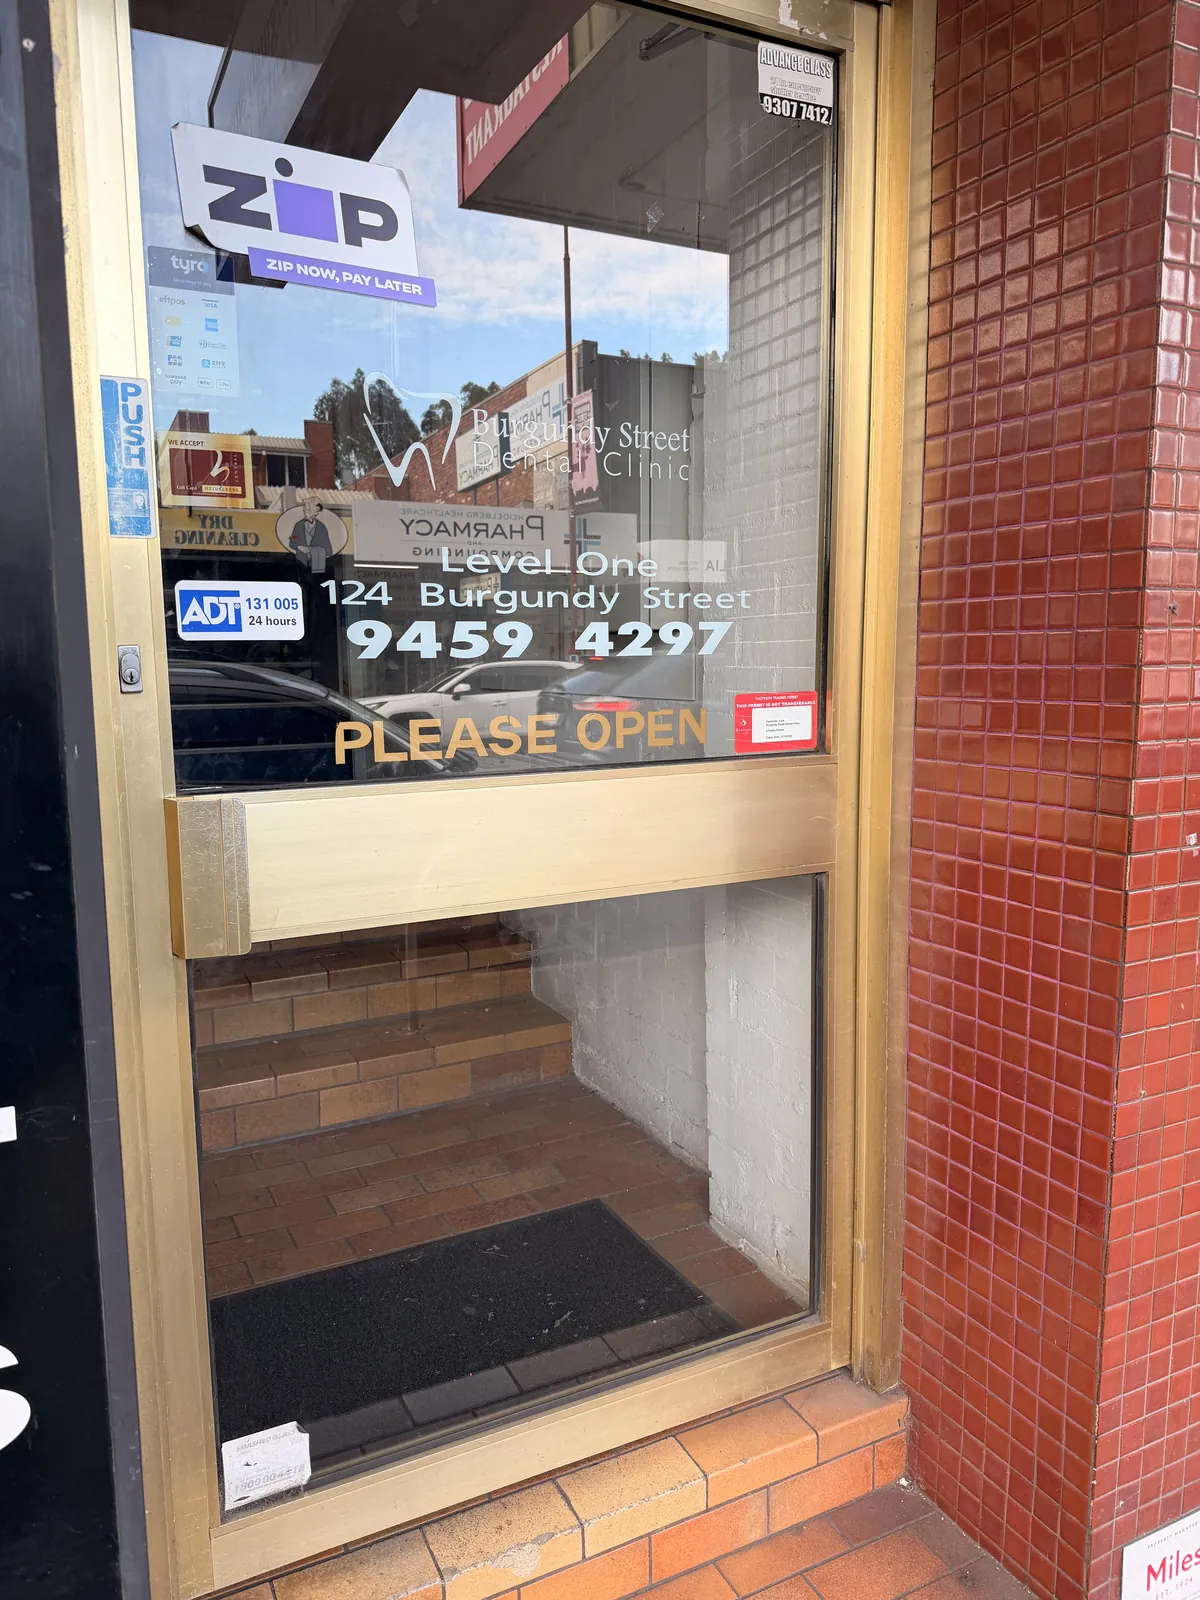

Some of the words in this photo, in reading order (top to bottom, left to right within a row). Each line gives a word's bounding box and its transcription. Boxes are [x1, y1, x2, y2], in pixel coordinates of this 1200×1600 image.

[760, 46, 803, 72] ADVANCE
[804, 56, 833, 79] GLASS
[763, 95, 797, 118] 9307
[800, 103, 829, 125] 7412
[794, 91, 816, 102] service
[171, 254, 209, 275] tyro
[266, 257, 294, 272] ZIP
[296, 263, 340, 284] NOW,
[342, 271, 371, 286] PAY
[375, 276, 423, 296] LATER
[159, 295, 186, 306] eftpos
[120, 382, 147, 468] PUSH
[471, 408, 611, 452] Burgundy
[619, 421, 690, 452] Street
[473, 441, 582, 474] Dental
[603, 452, 690, 481] Clinic
[441, 546, 551, 575] Level
[576, 551, 658, 577] One
[181, 596, 240, 625] ADT
[245, 598, 269, 610] 131
[274, 598, 299, 610] 005
[320, 579, 393, 606] 124
[420, 582, 620, 614] Burgundy
[643, 587, 751, 609] Street
[249, 616, 262, 626] 24
[266, 616, 297, 626] hours
[346, 619, 534, 659] 9459
[574, 621, 733, 657] 4297
[335, 714, 557, 765] PLEASE
[576, 708, 706, 751] OPEN
[1147, 1534, 1173, 1549] PROPERTY
